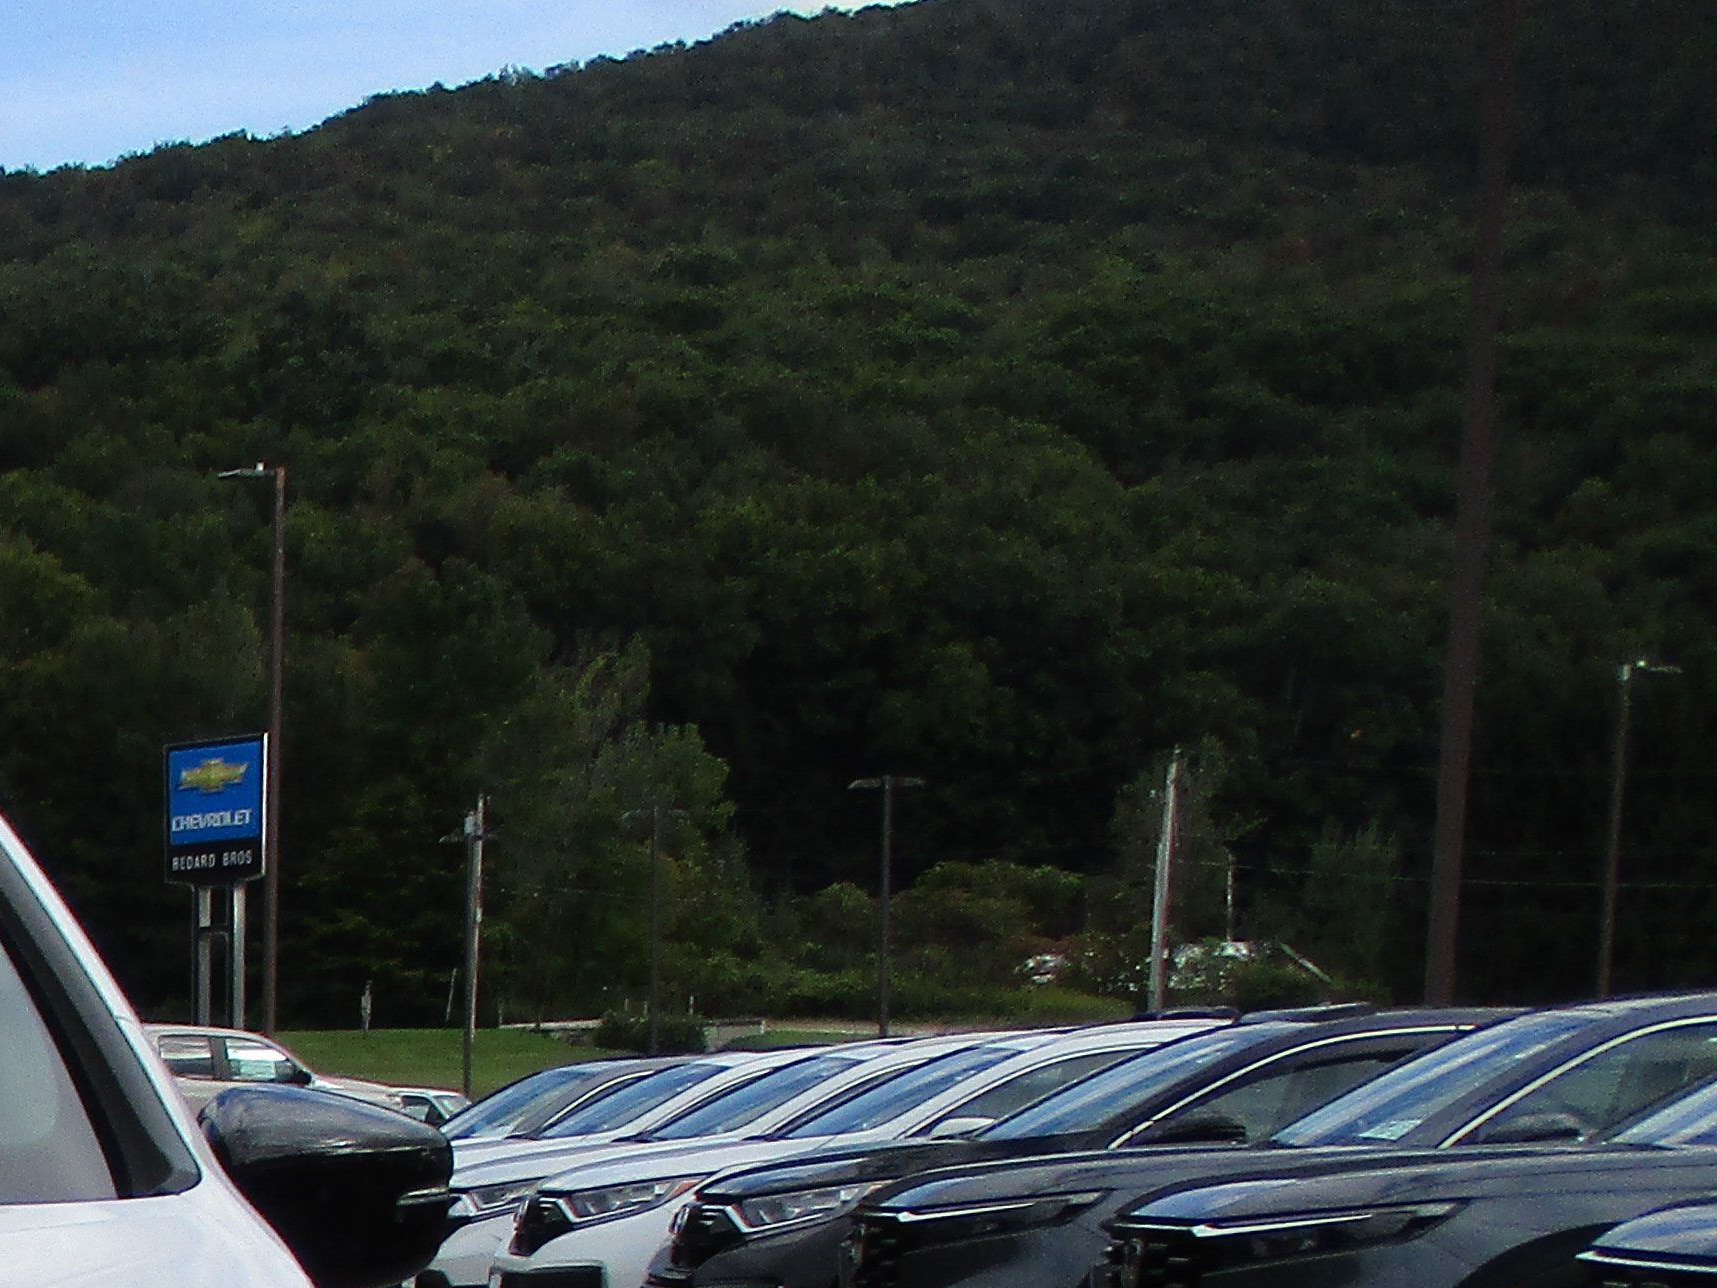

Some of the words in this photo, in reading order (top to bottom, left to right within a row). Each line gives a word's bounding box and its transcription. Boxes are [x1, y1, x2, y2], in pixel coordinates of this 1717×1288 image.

[171, 808, 251, 831] CHEVROLET
[172, 853, 215, 872] BEDARD
[222, 849, 252, 866] BROS
